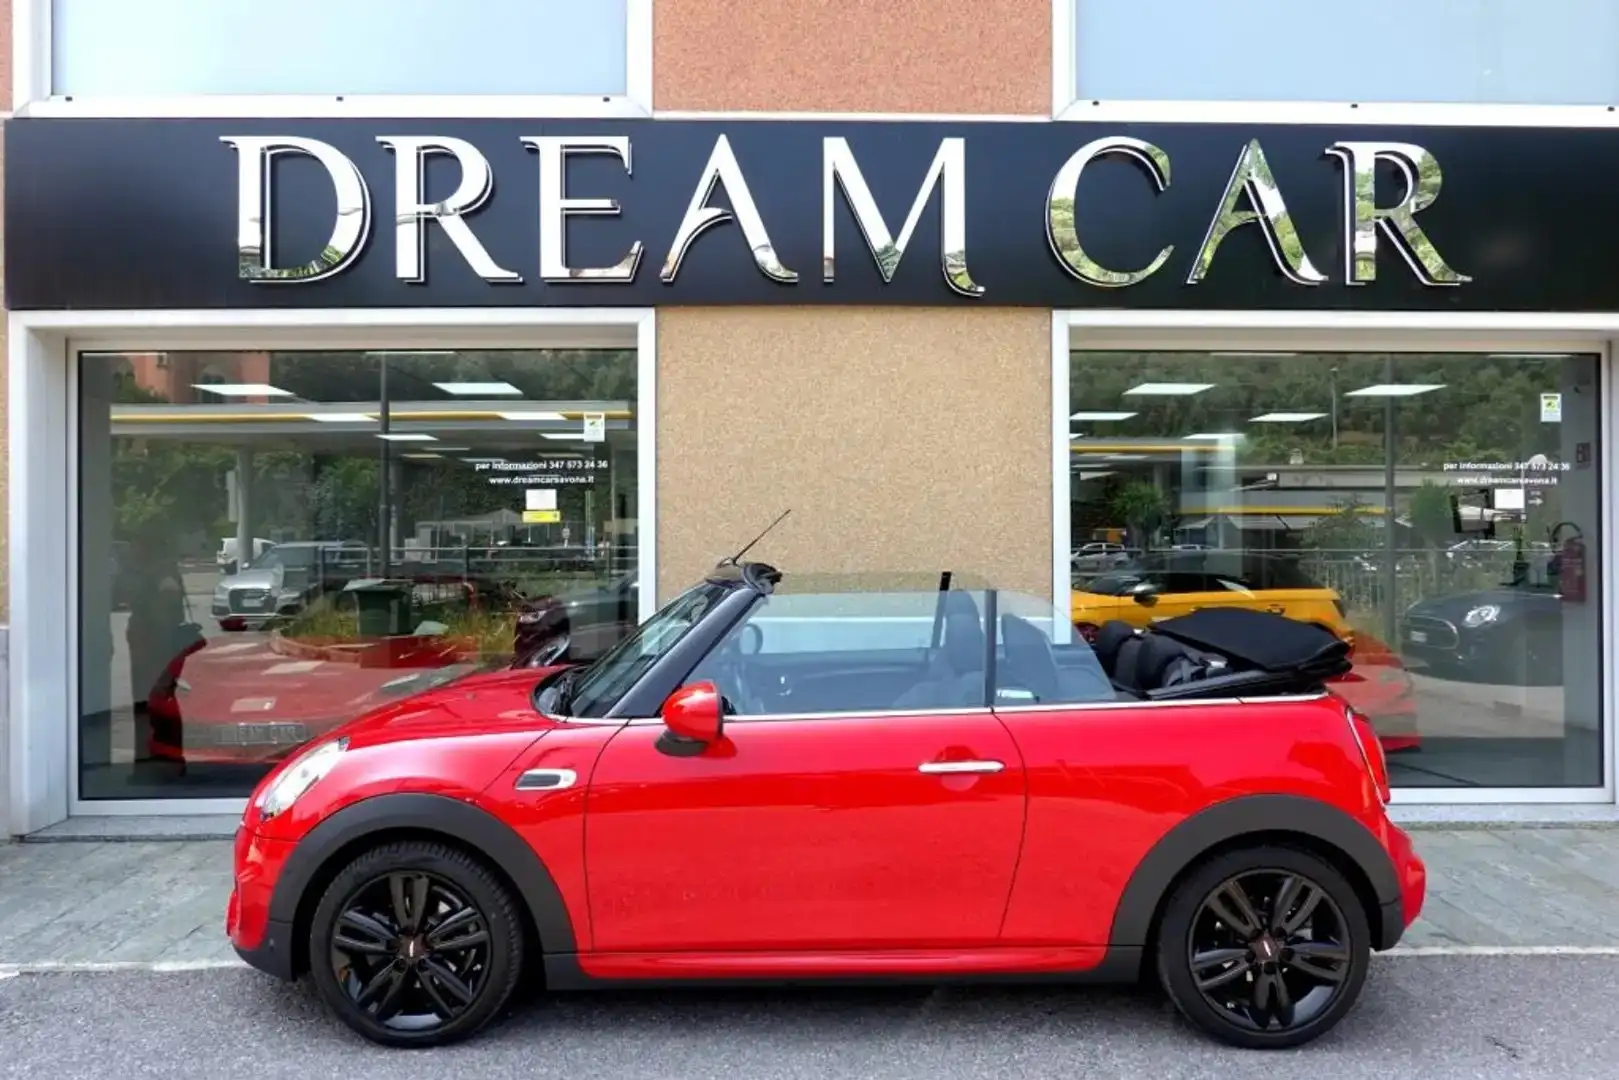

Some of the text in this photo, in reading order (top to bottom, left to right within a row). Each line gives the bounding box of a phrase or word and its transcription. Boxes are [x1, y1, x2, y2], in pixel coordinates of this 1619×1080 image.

[219, 134, 1472, 297] DREAM CAR
[475, 462, 490, 472] per
[492, 460, 546, 470] informazioni
[549, 460, 565, 469] 347
[1444, 462, 1457, 472] per
[1460, 461, 1512, 470] informazioni
[489, 475, 594, 484] www.dreamcarsavona.it
